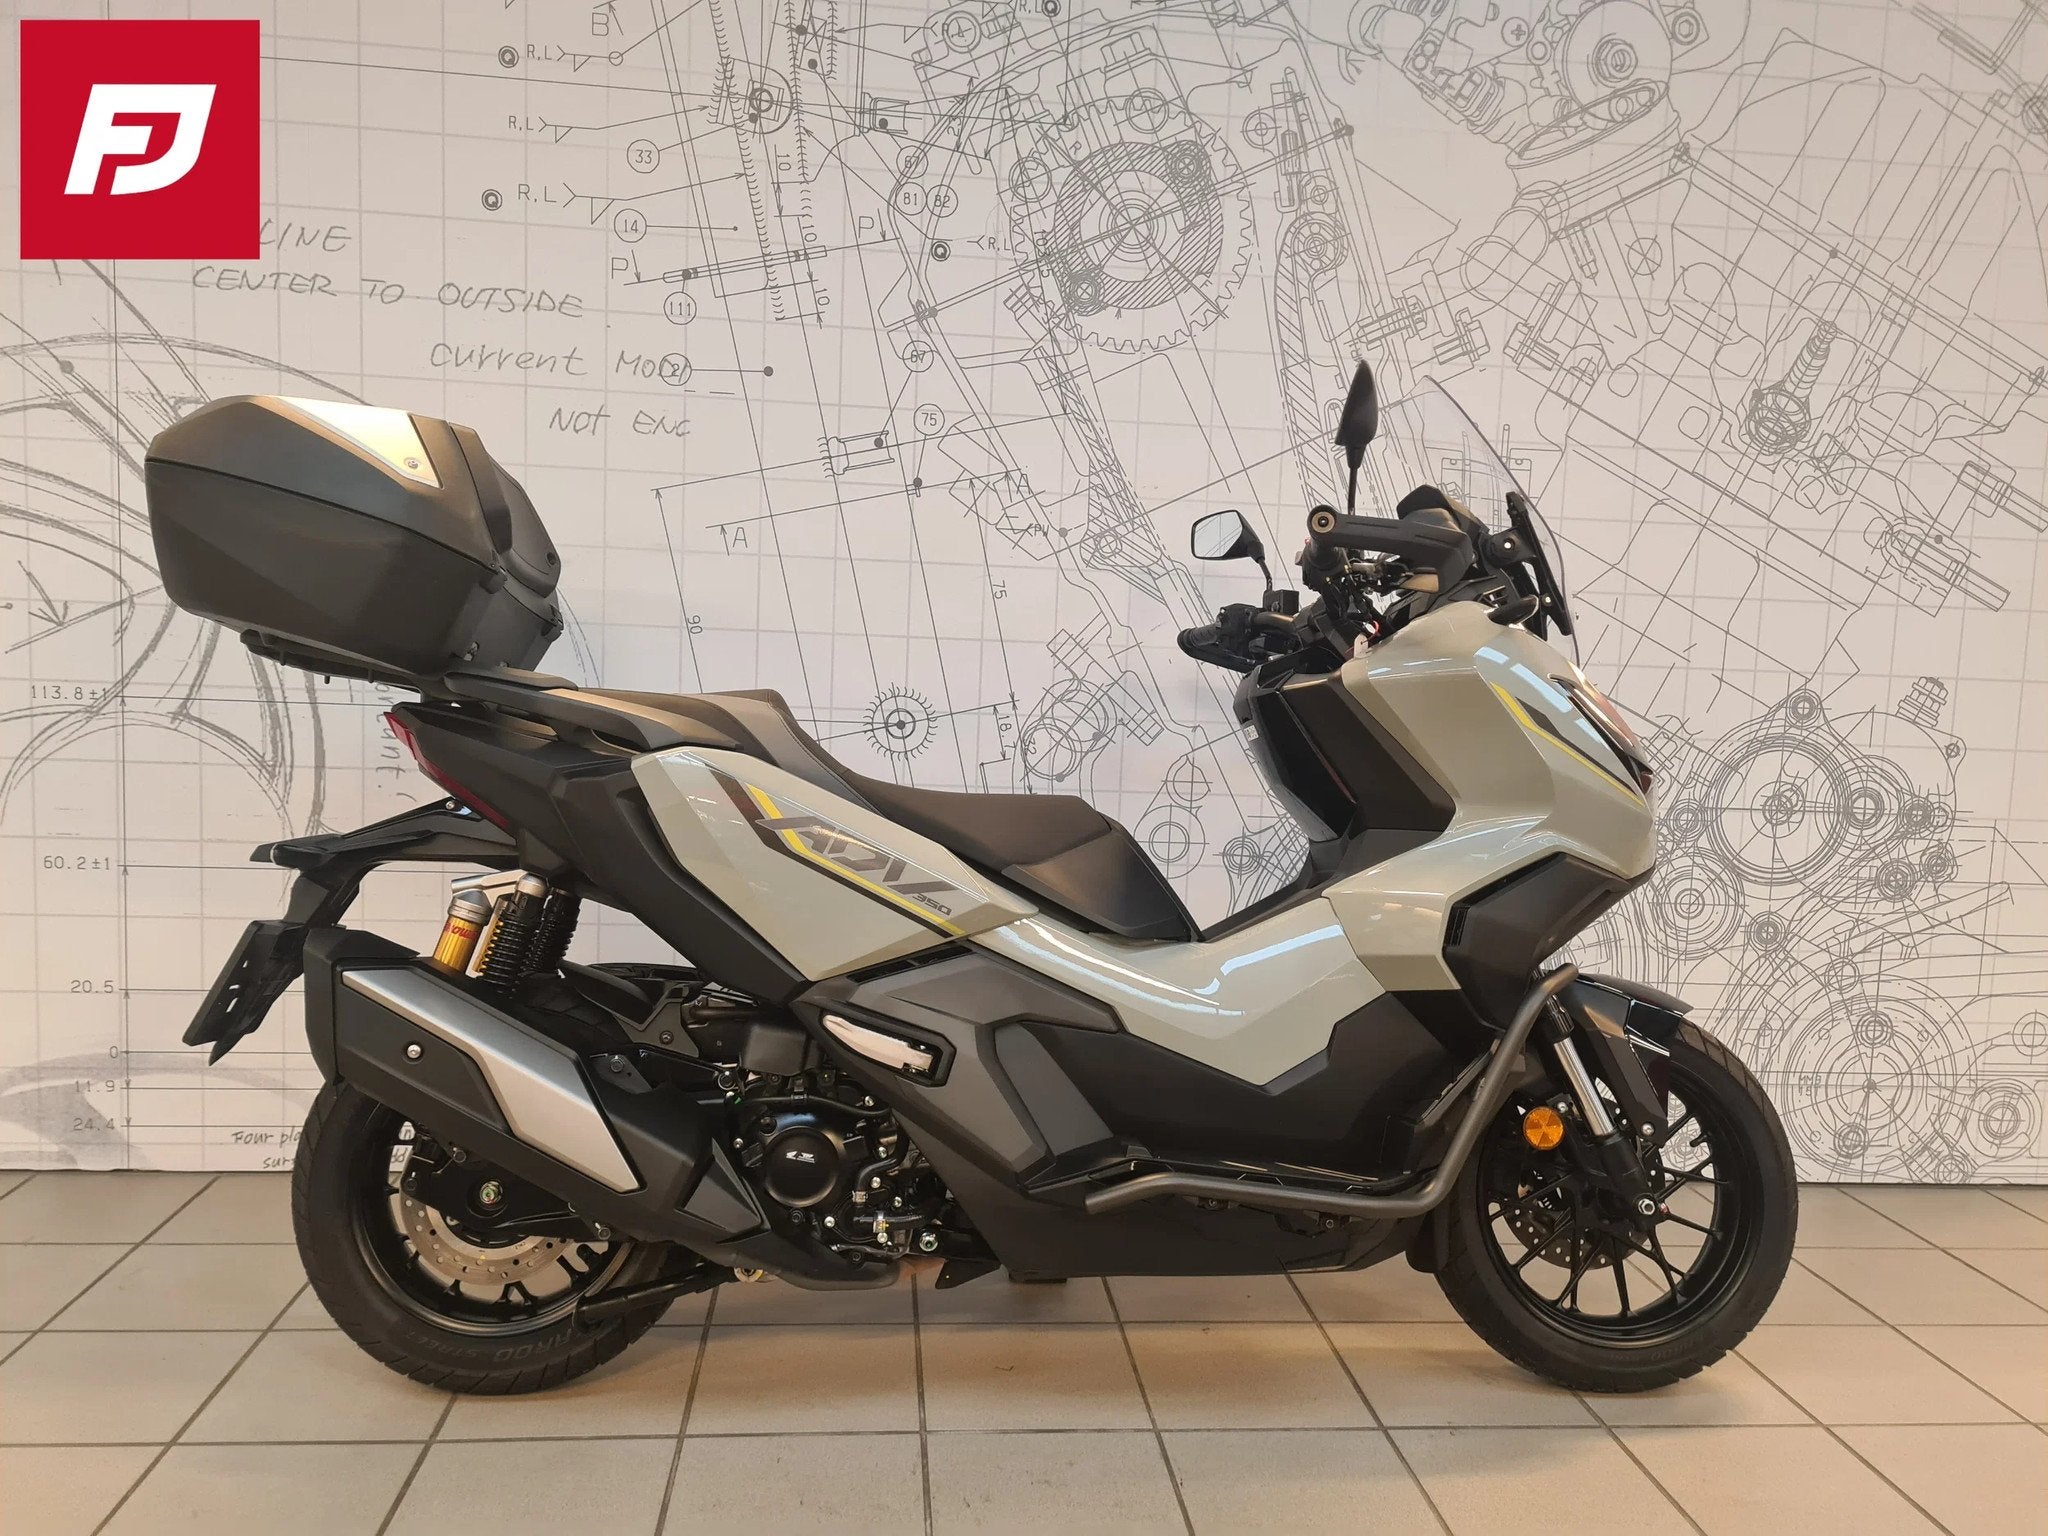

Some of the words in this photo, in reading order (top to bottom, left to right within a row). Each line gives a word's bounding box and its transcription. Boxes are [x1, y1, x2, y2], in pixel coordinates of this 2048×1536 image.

[591, 12, 610, 37] B
[634, 149, 653, 165] 33
[902, 192, 918, 207] 81
[933, 194, 951, 209] 82
[623, 218, 639, 234] 14
[858, 215, 875, 239] P
[611, 257, 629, 279] P
[192, 265, 338, 297] CENTER
[361, 278, 405, 304] TO
[437, 282, 583, 318] OUTSIDE
[669, 301, 692, 317] 111
[921, 412, 938, 427] 75
[732, 526, 748, 549] A
[991, 578, 1008, 600] 75
[687, 614, 703, 635] 90
[912, 893, 952, 916] 350
[70, 979, 114, 994] 20.5
[109, 1045, 118, 1059] 0
[74, 1079, 115, 1093] 11.9
[73, 1117, 115, 1132] 24.4
[231, 1130, 274, 1145] Four
